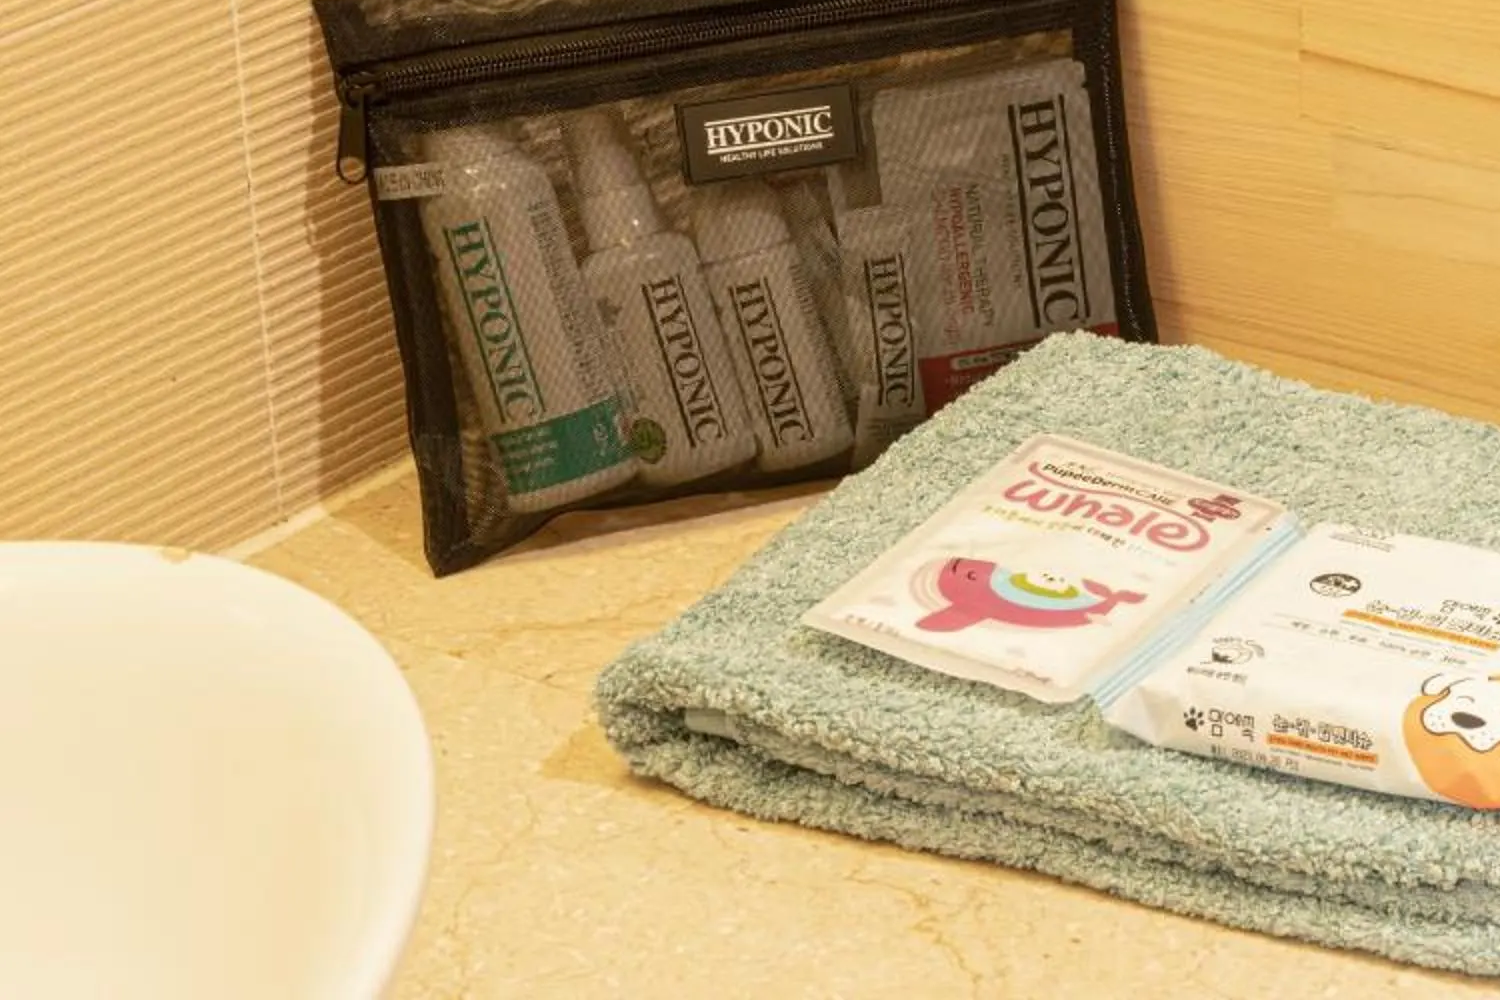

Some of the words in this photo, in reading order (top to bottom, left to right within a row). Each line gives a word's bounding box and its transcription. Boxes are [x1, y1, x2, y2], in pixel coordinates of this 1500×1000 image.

[704, 111, 833, 149] HYPONIC
[1019, 99, 1080, 326] HYPONIC
[451, 220, 536, 422] HYPONIC
[651, 278, 723, 442] HYPONIC
[735, 281, 807, 444] HYPONIC
[871, 254, 910, 408] HYPONIC
